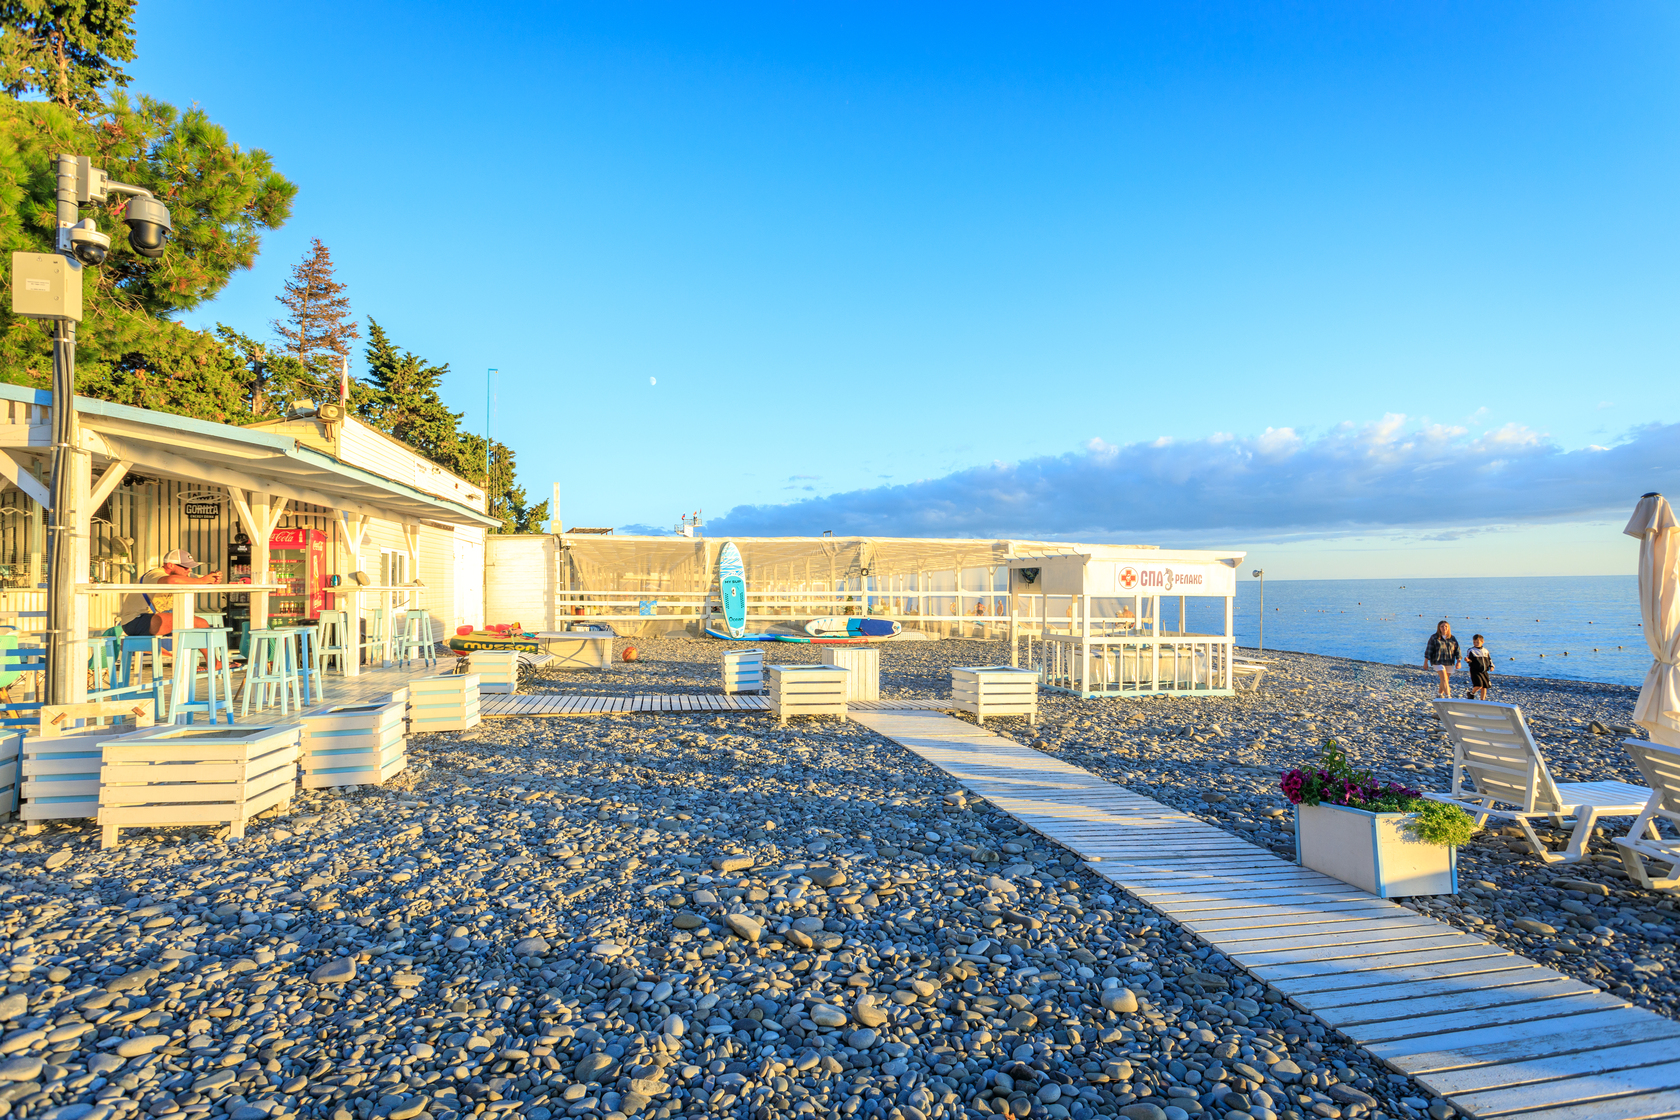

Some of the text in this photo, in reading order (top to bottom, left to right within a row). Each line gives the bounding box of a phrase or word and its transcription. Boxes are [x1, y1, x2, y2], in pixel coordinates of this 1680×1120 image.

[186, 504, 219, 515] GORILLA
[1140, 570, 1203, 586] СПА РЕЛАКС
[464, 642, 535, 651] musson
